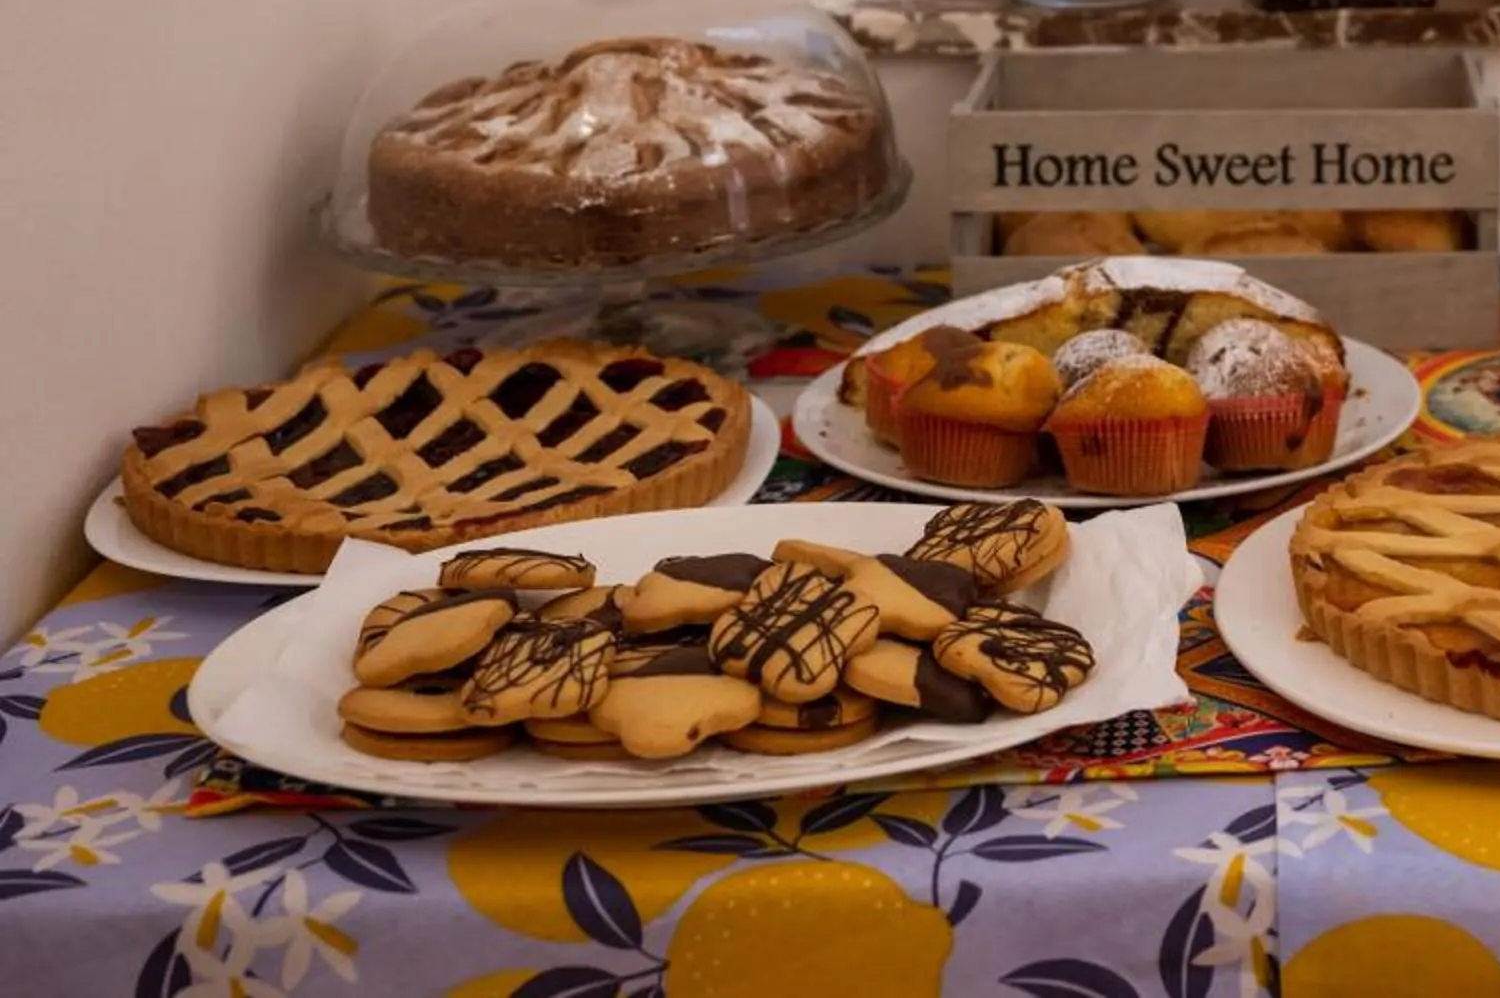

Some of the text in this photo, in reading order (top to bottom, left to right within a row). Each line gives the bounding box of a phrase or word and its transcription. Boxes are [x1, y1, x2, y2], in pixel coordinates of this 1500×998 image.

[990, 142, 1456, 188] Home Sweet Home
